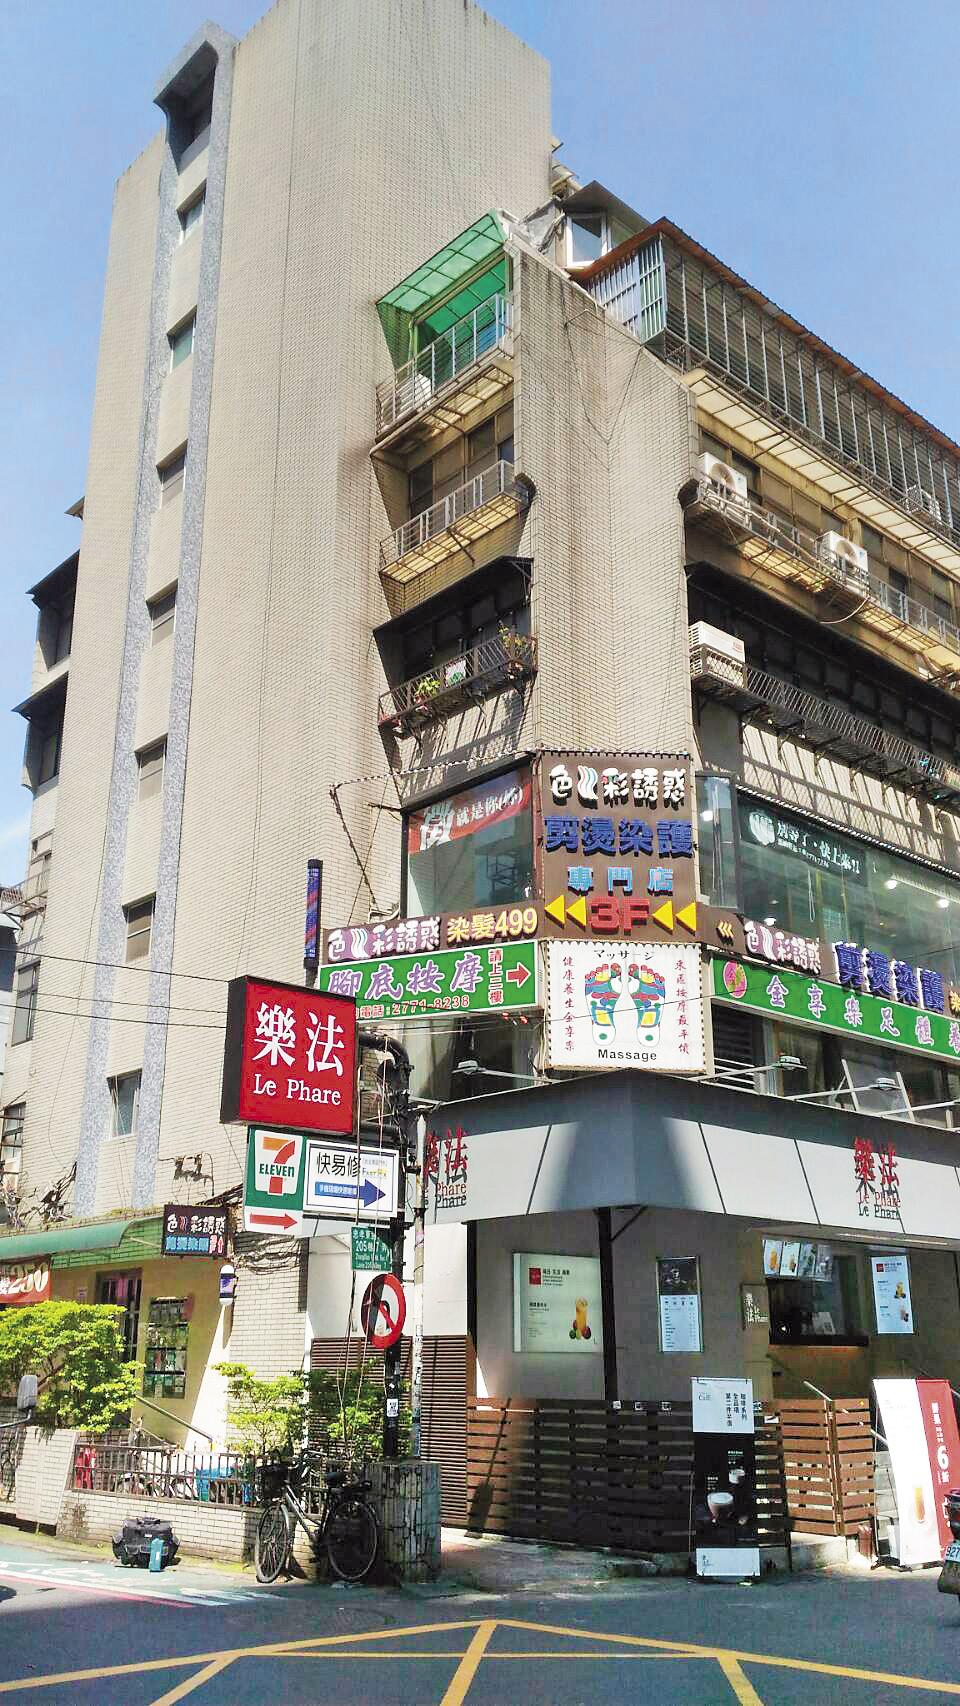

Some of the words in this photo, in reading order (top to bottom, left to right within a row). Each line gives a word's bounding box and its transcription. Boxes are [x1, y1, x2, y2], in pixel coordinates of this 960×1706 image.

[549, 764, 686, 802] 色彩誘惑
[544, 816, 693, 856] 剪燙染護
[567, 866, 674, 894] 專門店
[589, 896, 651, 933] 3F
[328, 915, 441, 960] 色彩誘惑
[446, 907, 538, 944] 染髮499
[744, 920, 821, 973] 色彩誘惑
[594, 949, 655, 961] マッサージ
[328, 951, 485, 1000] 腳底按摩
[488, 948, 505, 1005] 請上二樓
[355, 995, 470, 1019] 電話:2771-8238
[252, 1002, 345, 1076] 樂法
[598, 1049, 658, 1062] Massage
[253, 1073, 277, 1096] Le
[286, 1078, 341, 1106] Phare
[317, 1152, 361, 1178] 快易修
[854, 1136, 900, 1187] 樂法
[167, 1214, 226, 1235] 色彩誘惑
